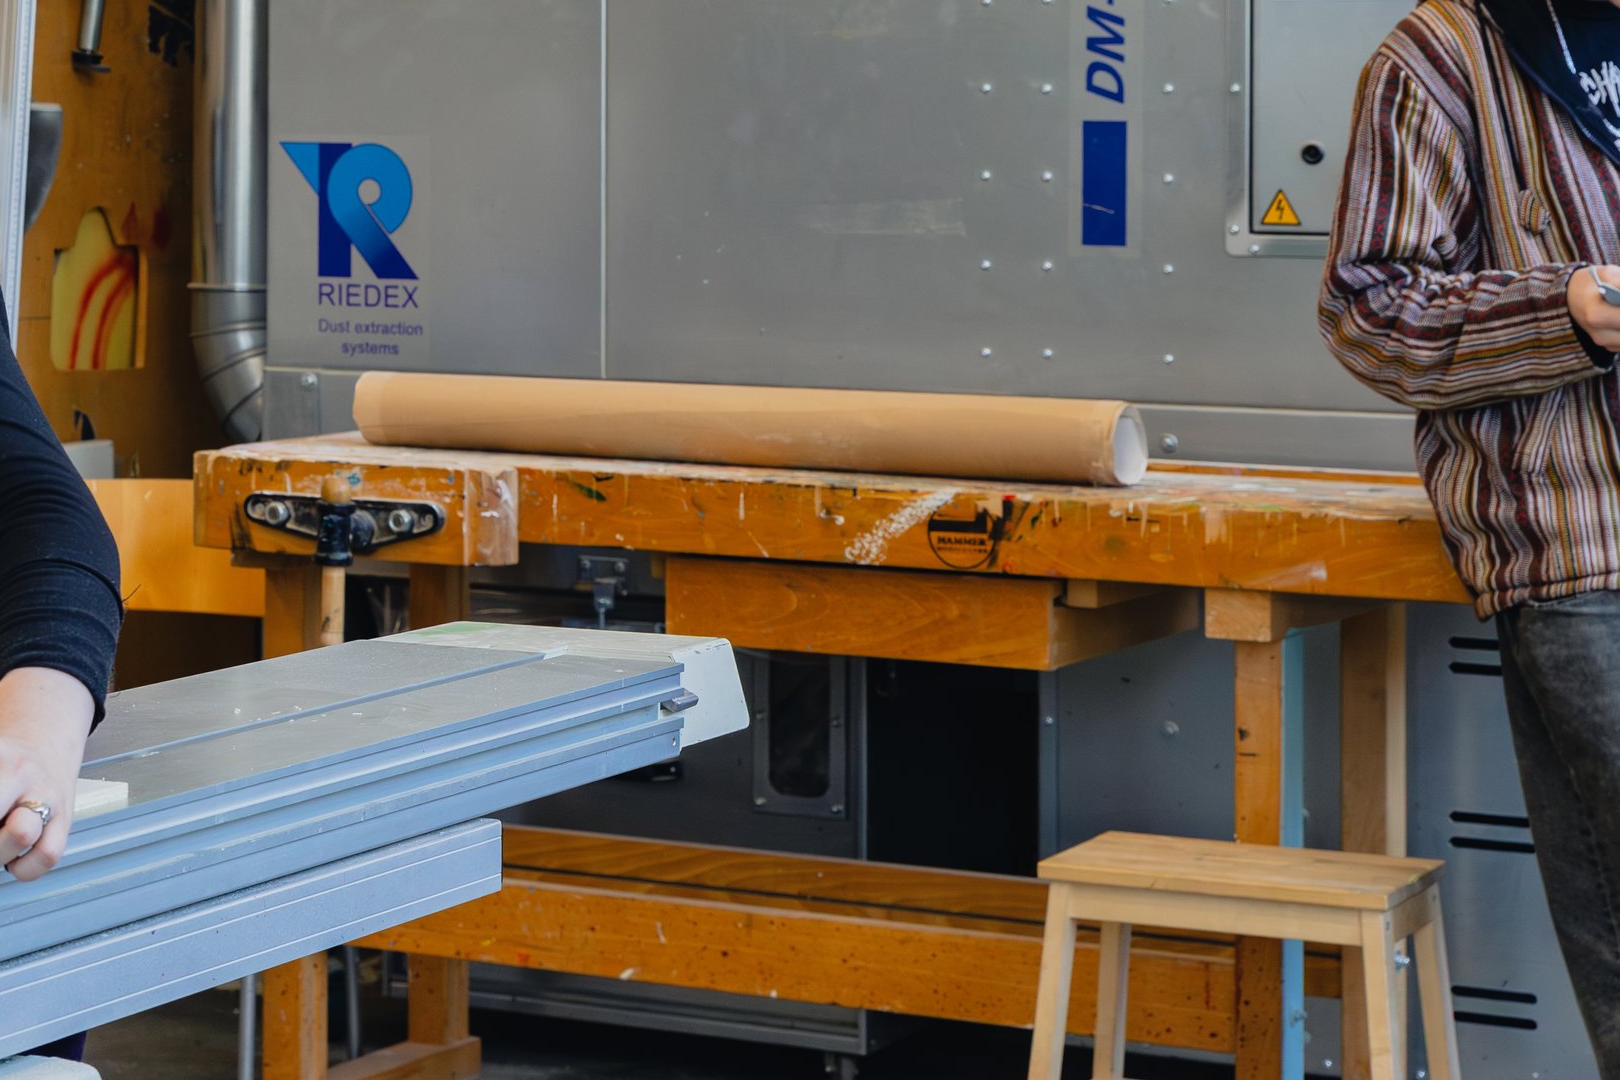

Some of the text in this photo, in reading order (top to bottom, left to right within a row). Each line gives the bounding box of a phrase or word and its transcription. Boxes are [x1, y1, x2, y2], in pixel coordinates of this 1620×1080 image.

[318, 282, 420, 309] RIEDEX
[318, 318, 424, 336] Dust extraction
[341, 341, 400, 357] systems
